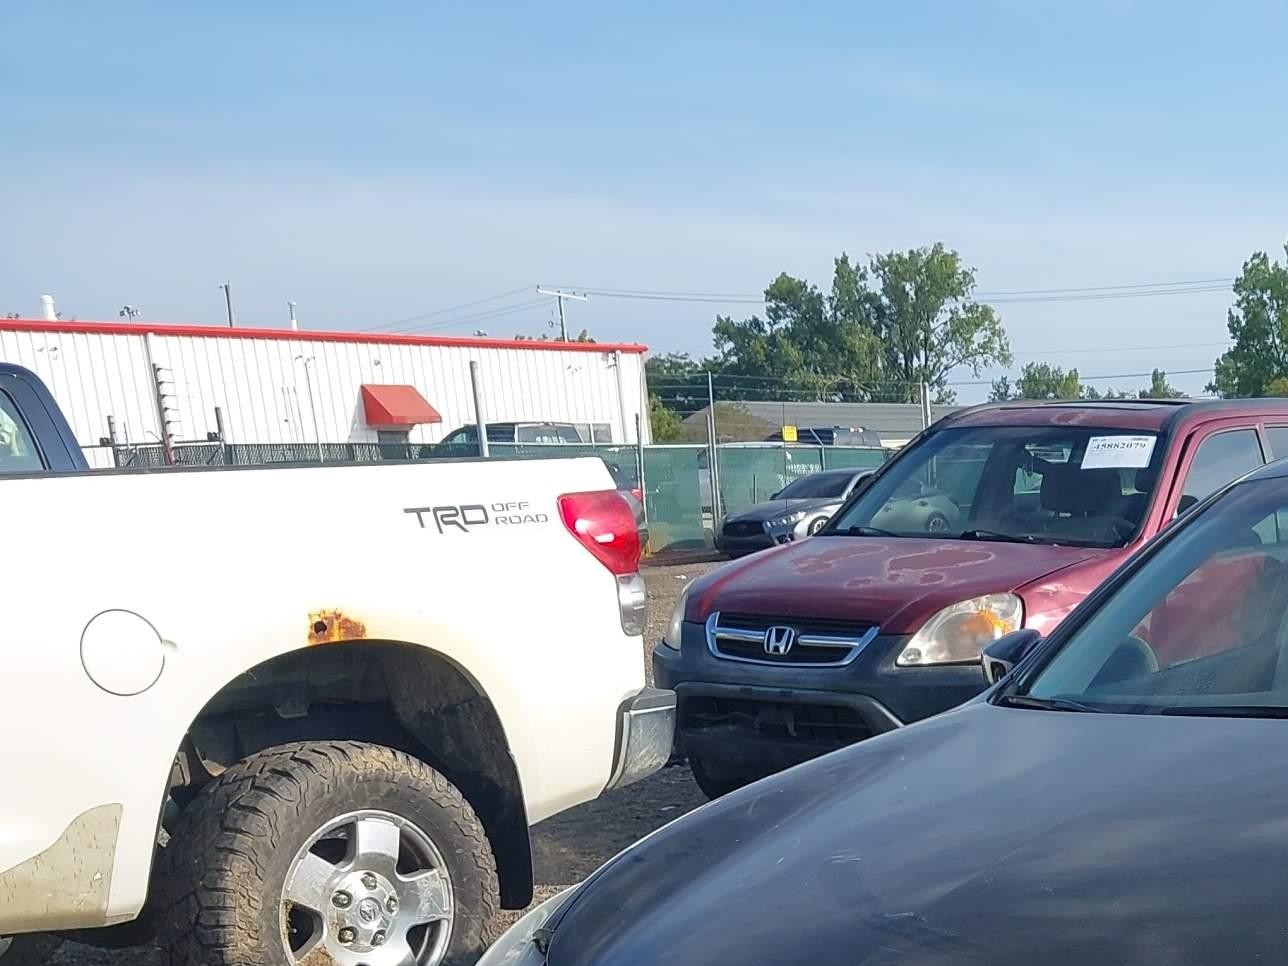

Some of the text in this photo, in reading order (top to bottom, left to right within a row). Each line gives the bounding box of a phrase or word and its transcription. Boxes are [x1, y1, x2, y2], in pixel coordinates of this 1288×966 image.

[491, 501, 529, 512] OFF
[403, 504, 489, 534] TRD
[495, 513, 549, 526] ROAD
